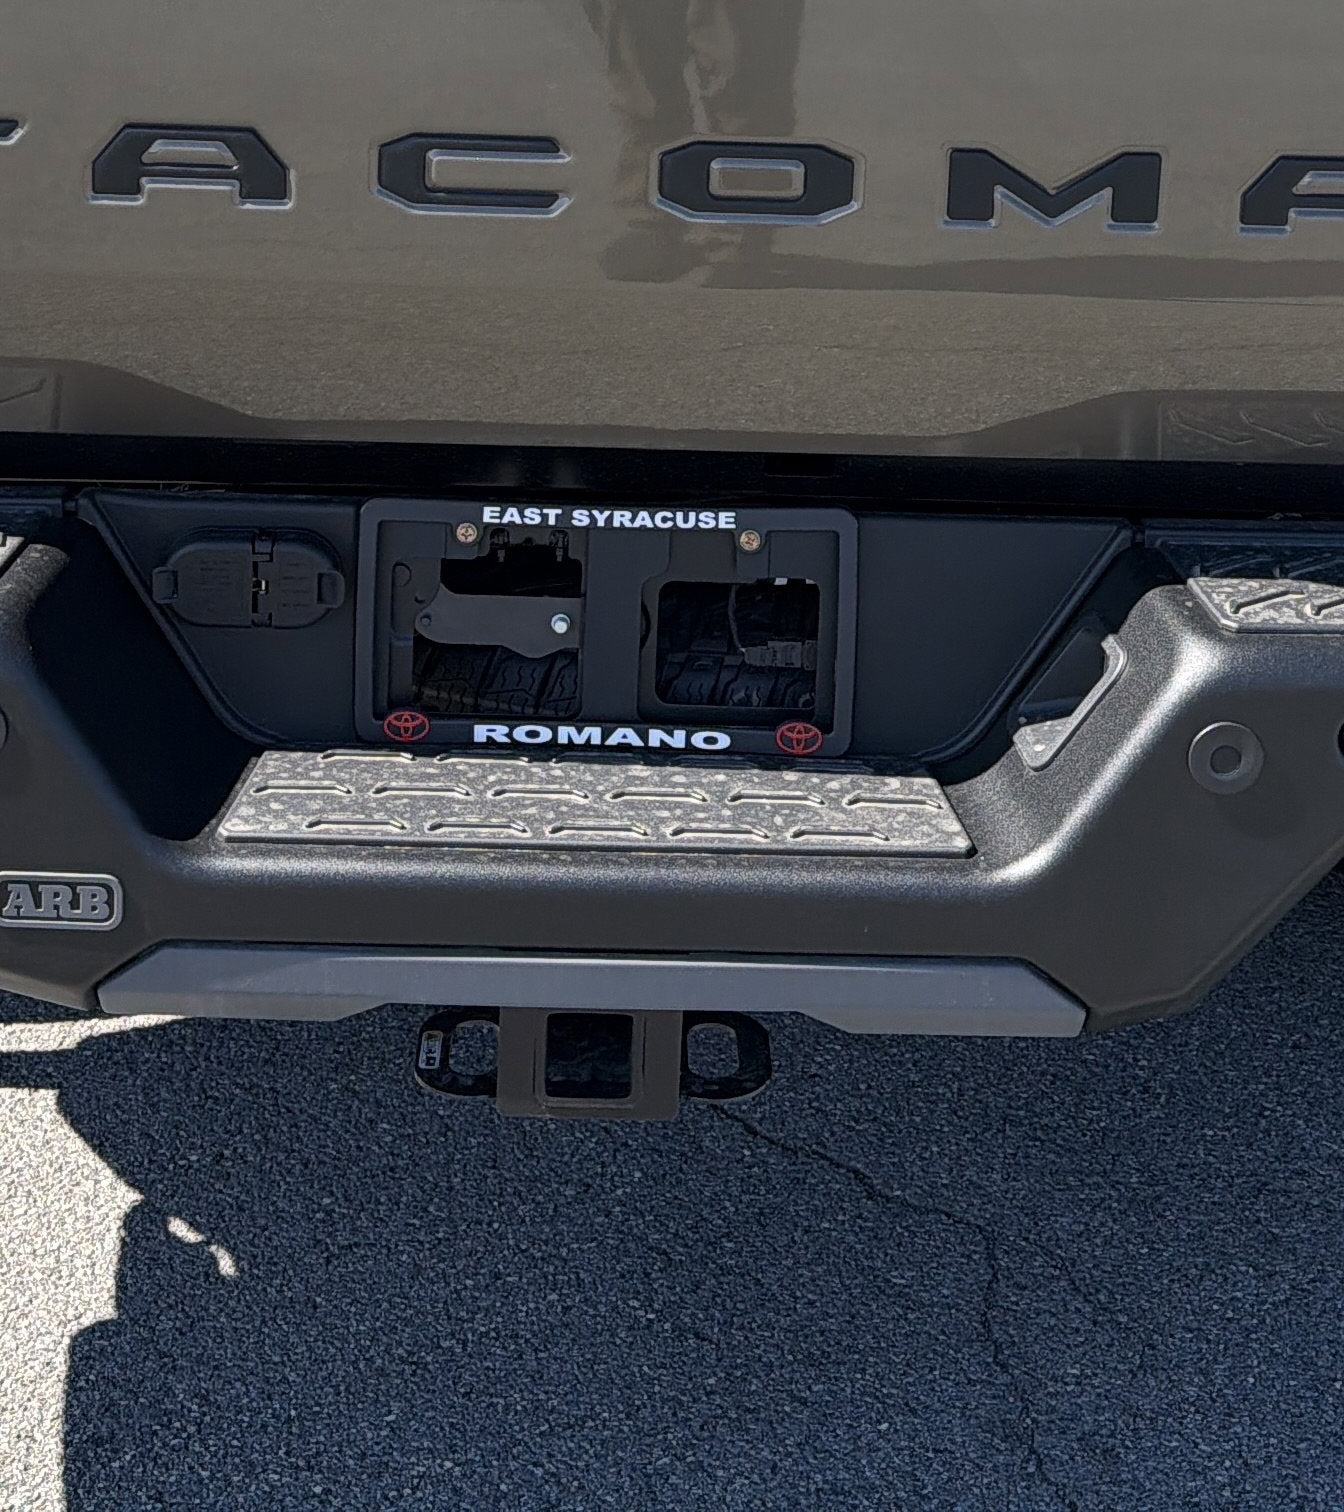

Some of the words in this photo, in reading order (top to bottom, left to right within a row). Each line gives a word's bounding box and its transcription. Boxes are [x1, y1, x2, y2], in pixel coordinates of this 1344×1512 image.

[482, 506, 562, 526] EAST
[571, 509, 737, 530] SYRACUSE
[473, 724, 732, 751] ROMANO
[1, 882, 111, 920] ARB
